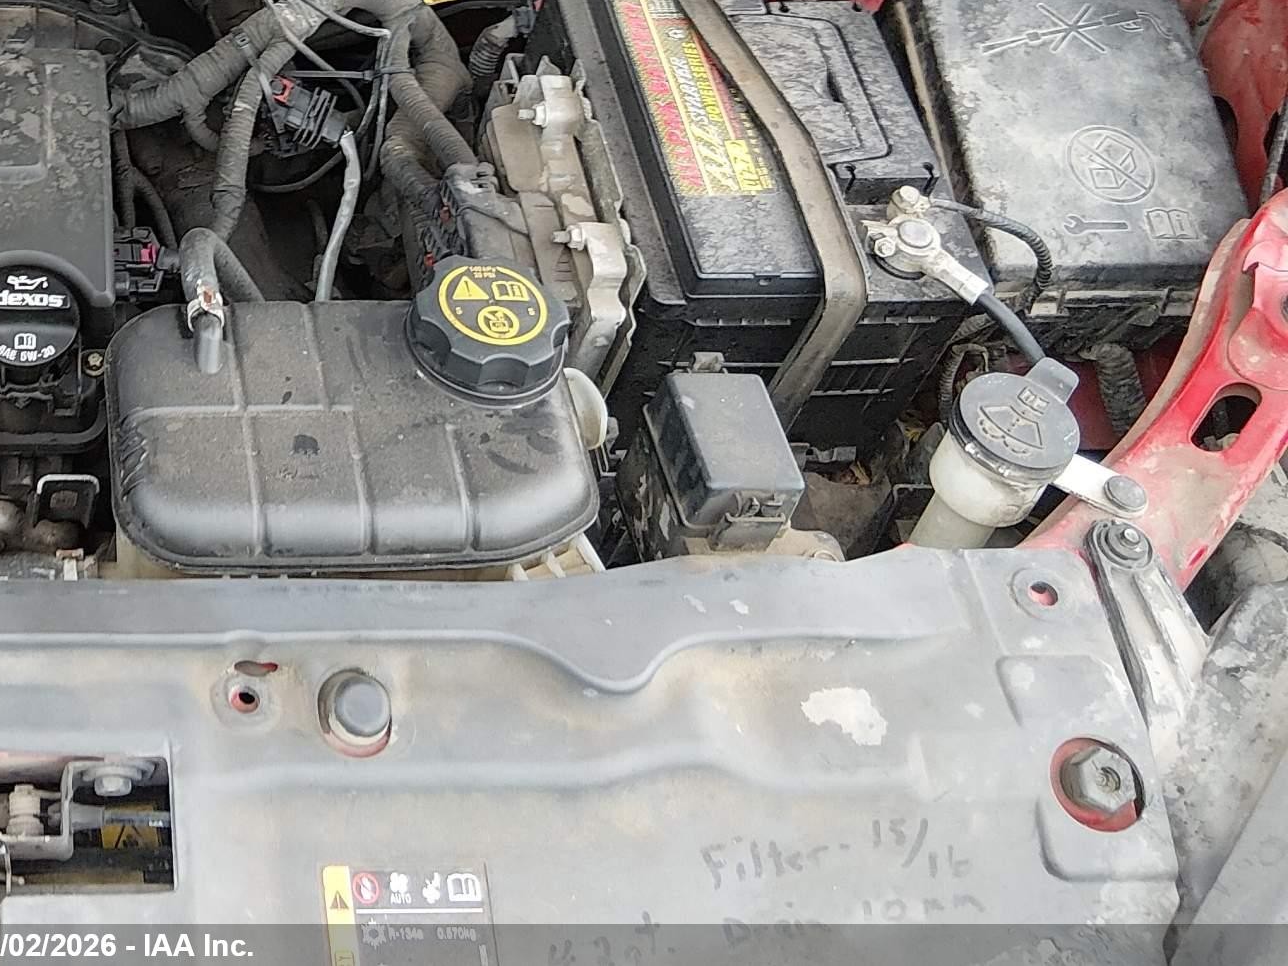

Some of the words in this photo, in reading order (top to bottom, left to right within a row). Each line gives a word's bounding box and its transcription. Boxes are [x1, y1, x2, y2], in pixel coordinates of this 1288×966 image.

[682, 42, 707, 81] SERIES
[669, 56, 709, 125] STARTER
[696, 77, 723, 122] POWER
[390, 893, 412, 904] AUTO
